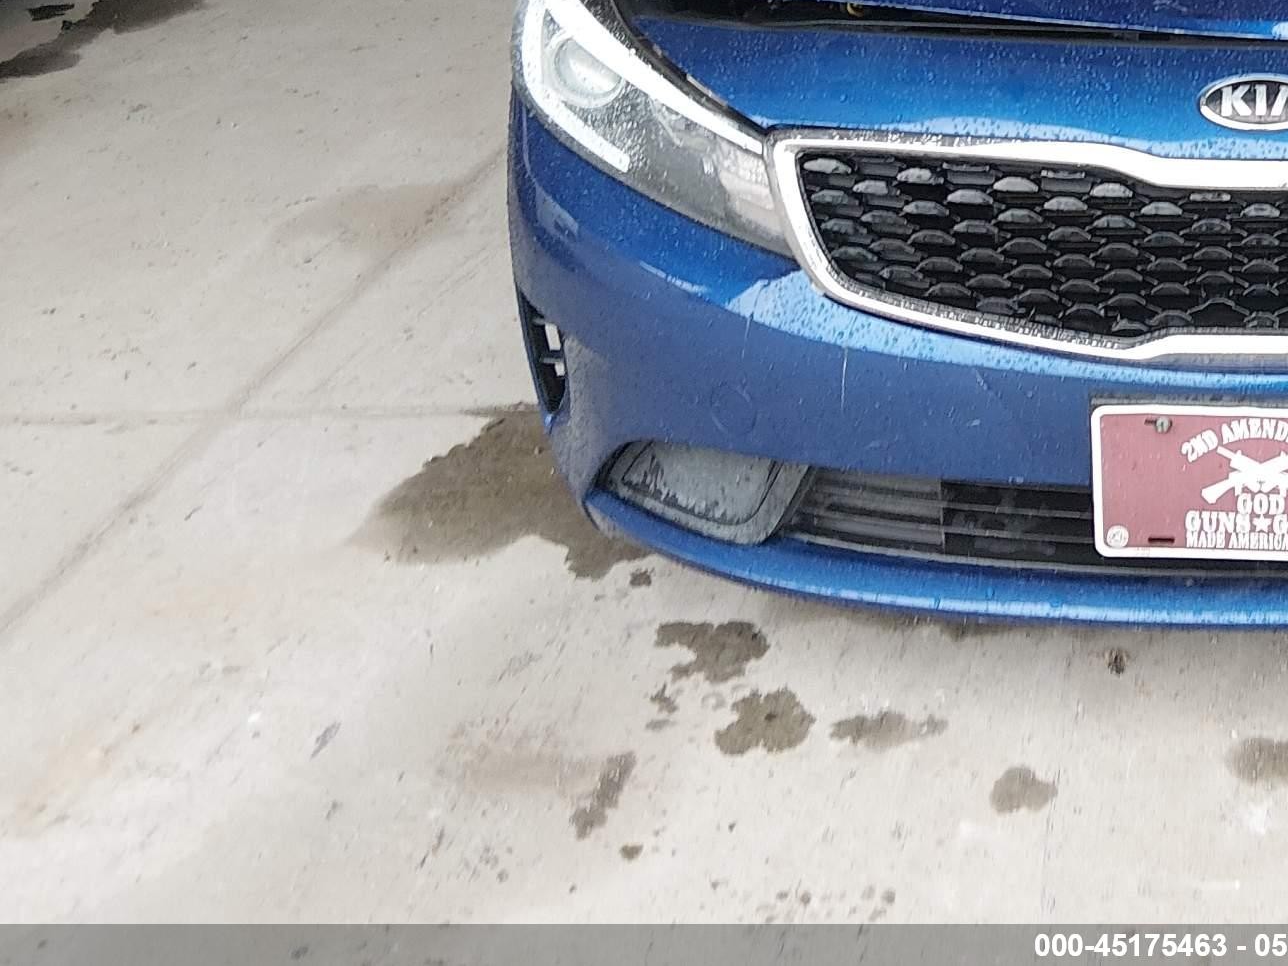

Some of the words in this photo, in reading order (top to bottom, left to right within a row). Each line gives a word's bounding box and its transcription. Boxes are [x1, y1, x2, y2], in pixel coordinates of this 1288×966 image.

[1181, 430, 1219, 462] 2ND
[1237, 494, 1285, 515] GOD
[1186, 531, 1225, 548] MADE
